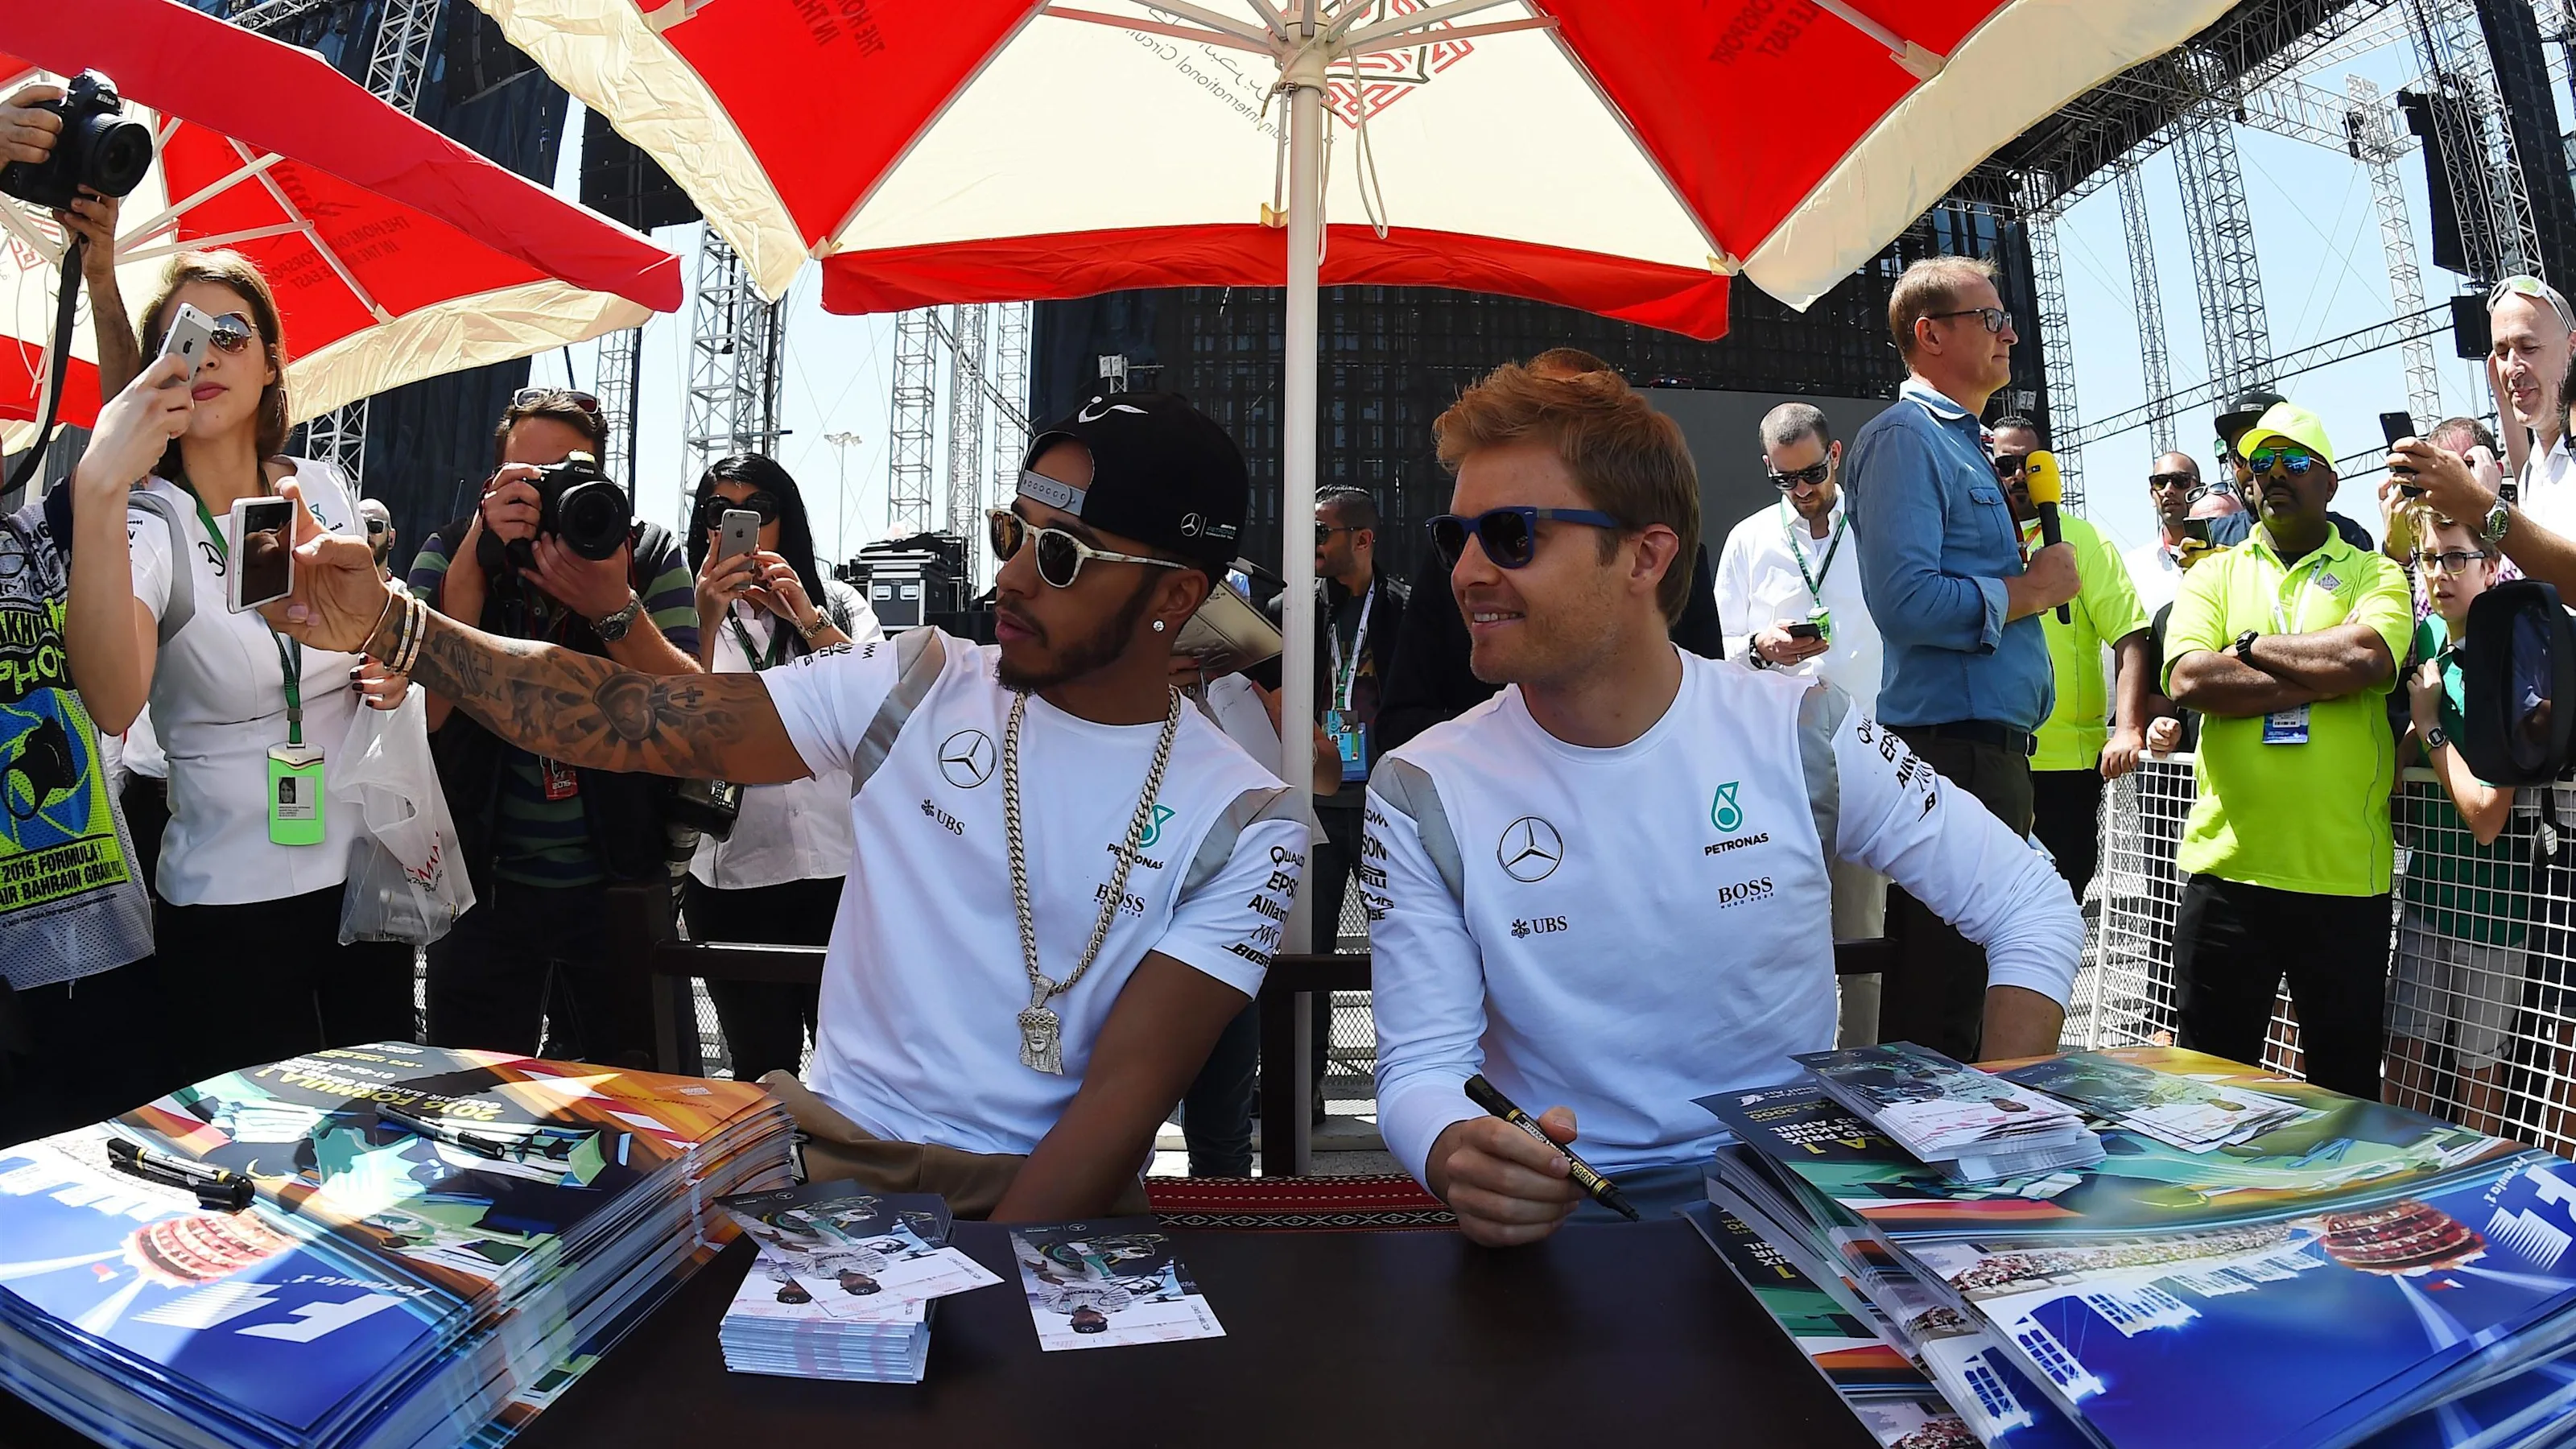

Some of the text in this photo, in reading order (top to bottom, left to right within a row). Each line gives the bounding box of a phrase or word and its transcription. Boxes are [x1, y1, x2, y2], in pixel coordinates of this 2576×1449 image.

[574, 465, 595, 475] Canon
[937, 808, 965, 836] UBS
[1107, 843, 1164, 869] PEONAS
[1704, 832, 1769, 857] PETRONAS
[2, 858, 36, 883] 2016
[38, 844, 97, 875] FORMULA
[21, 868, 83, 900] BAHRAIN
[1717, 876, 1773, 904] BOSS
[1531, 915, 1568, 934] UBS
[254, 1067, 275, 1079] 1
[278, 1071, 418, 1107] FORMULA
[420, 1099, 505, 1122] 2016
[1768, 1119, 1829, 1133] APRIL
[1777, 1124, 1859, 1140] SAKHIR
[1784, 1133, 1839, 1146] PRIX
[1802, 1141, 1827, 1155] 1
[1571, 1163, 1595, 1186] N860
[2490, 1155, 2529, 1195] Formula
[1773, 1265, 1798, 1279] 1
[315, 1274, 433, 1298] Formula
